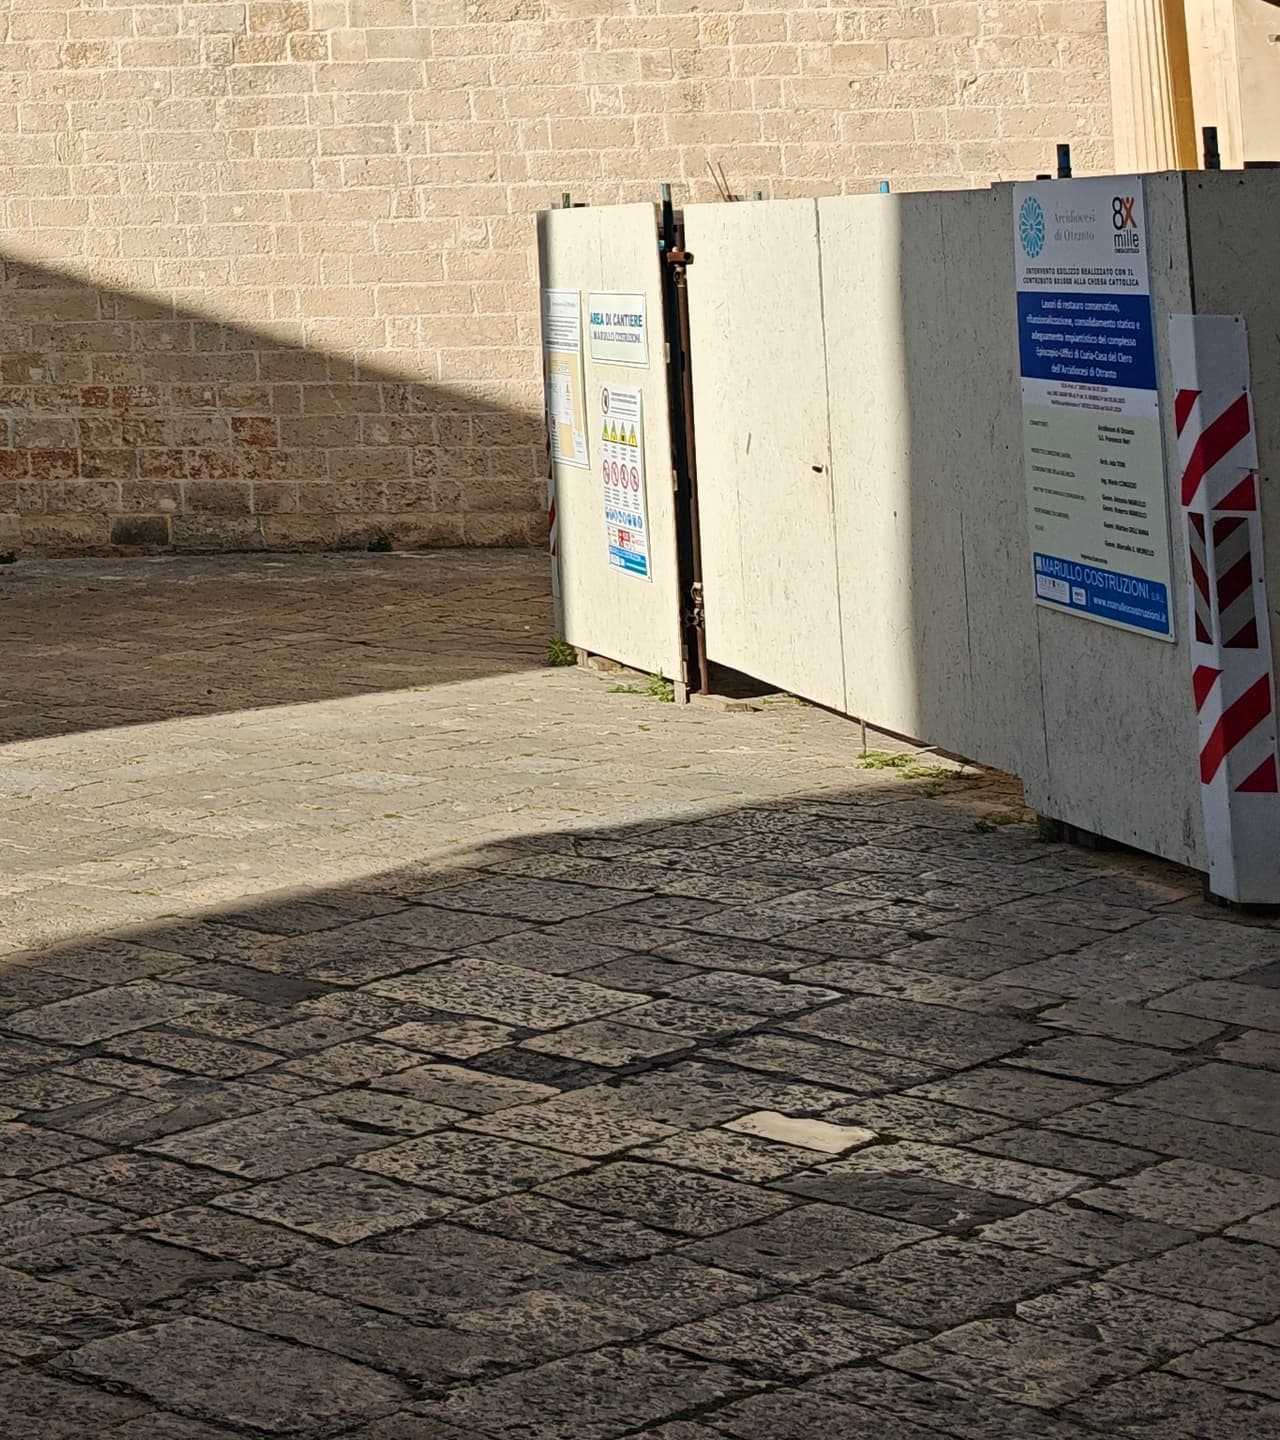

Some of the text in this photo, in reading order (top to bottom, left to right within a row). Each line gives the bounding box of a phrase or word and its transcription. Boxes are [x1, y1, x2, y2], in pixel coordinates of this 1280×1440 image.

[1054, 228, 1095, 241] di Otranto
[1113, 228, 1139, 248] mille
[1114, 268, 1126, 276] CON
[1087, 278, 1107, 286] CHIESA
[1108, 278, 1139, 287] CATTOLICA
[590, 311, 643, 328] AREA DI CANTIERE
[1095, 367, 1117, 379] Otranto
[1042, 556, 1083, 582] MARULLO
[1083, 568, 1149, 600] COSTRUZIONI
